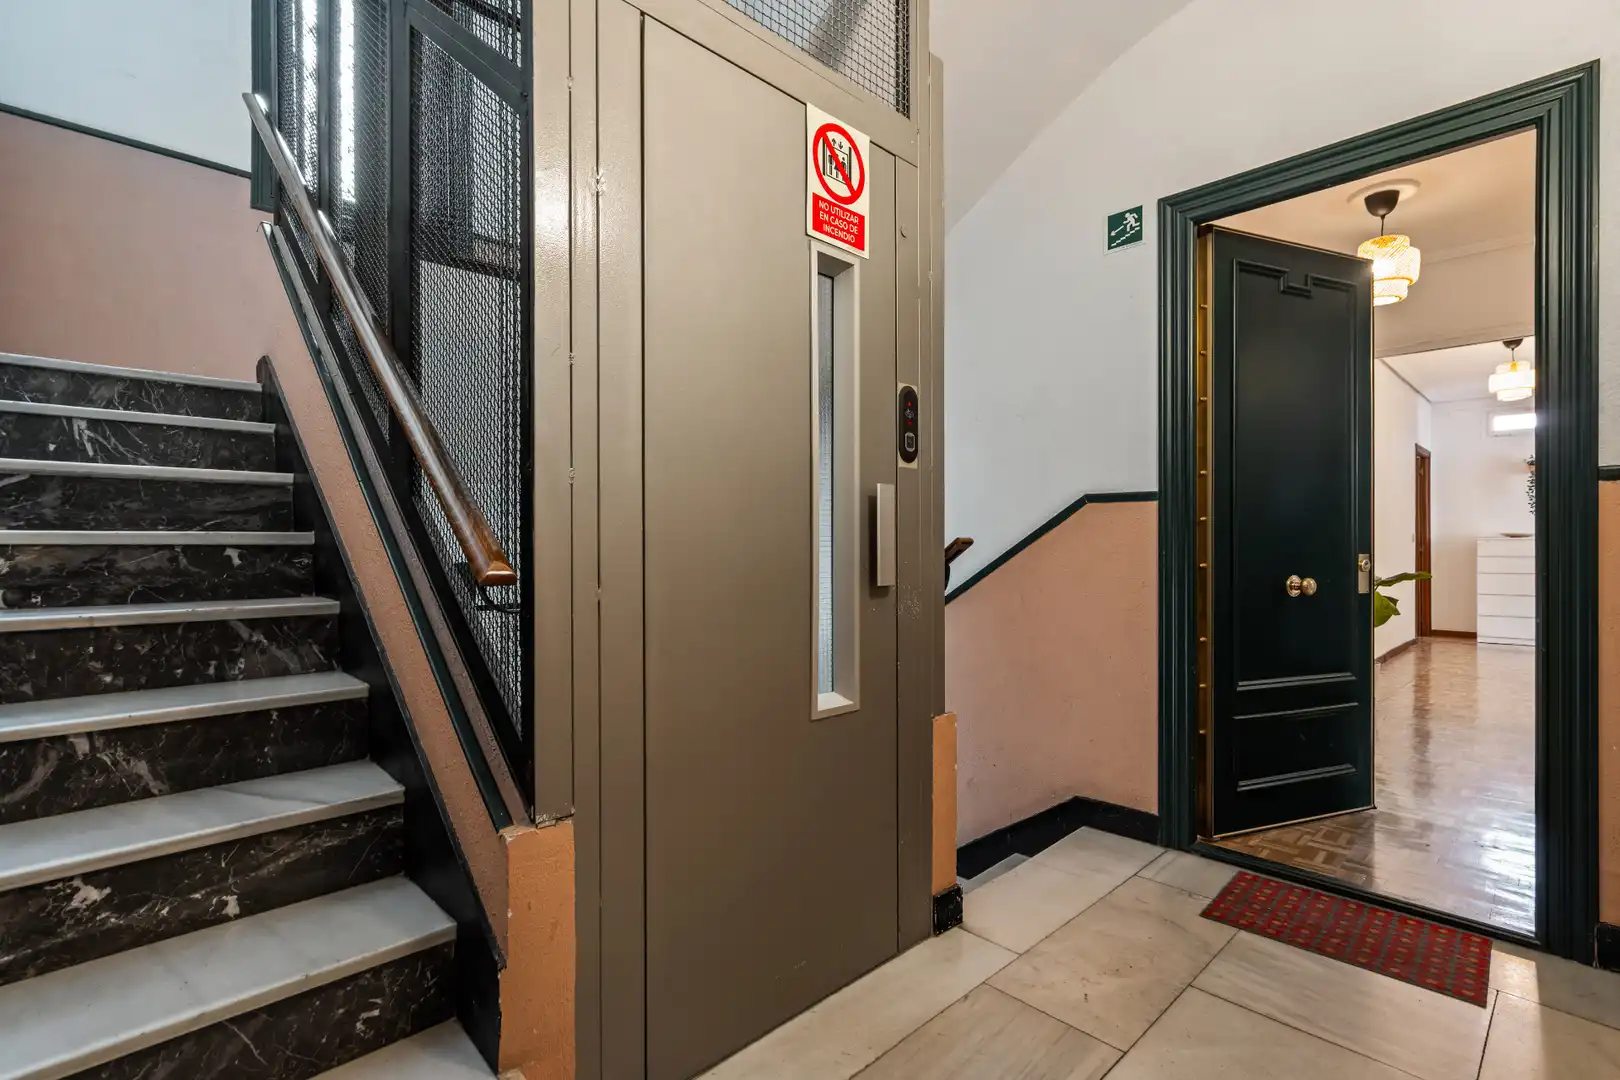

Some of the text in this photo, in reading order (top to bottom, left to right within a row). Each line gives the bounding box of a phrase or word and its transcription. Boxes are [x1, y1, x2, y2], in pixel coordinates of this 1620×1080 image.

[819, 200, 859, 225] NO UTILIZAR
[820, 211, 858, 235] EN CASO DE
[822, 223, 856, 243] INCENDIO
